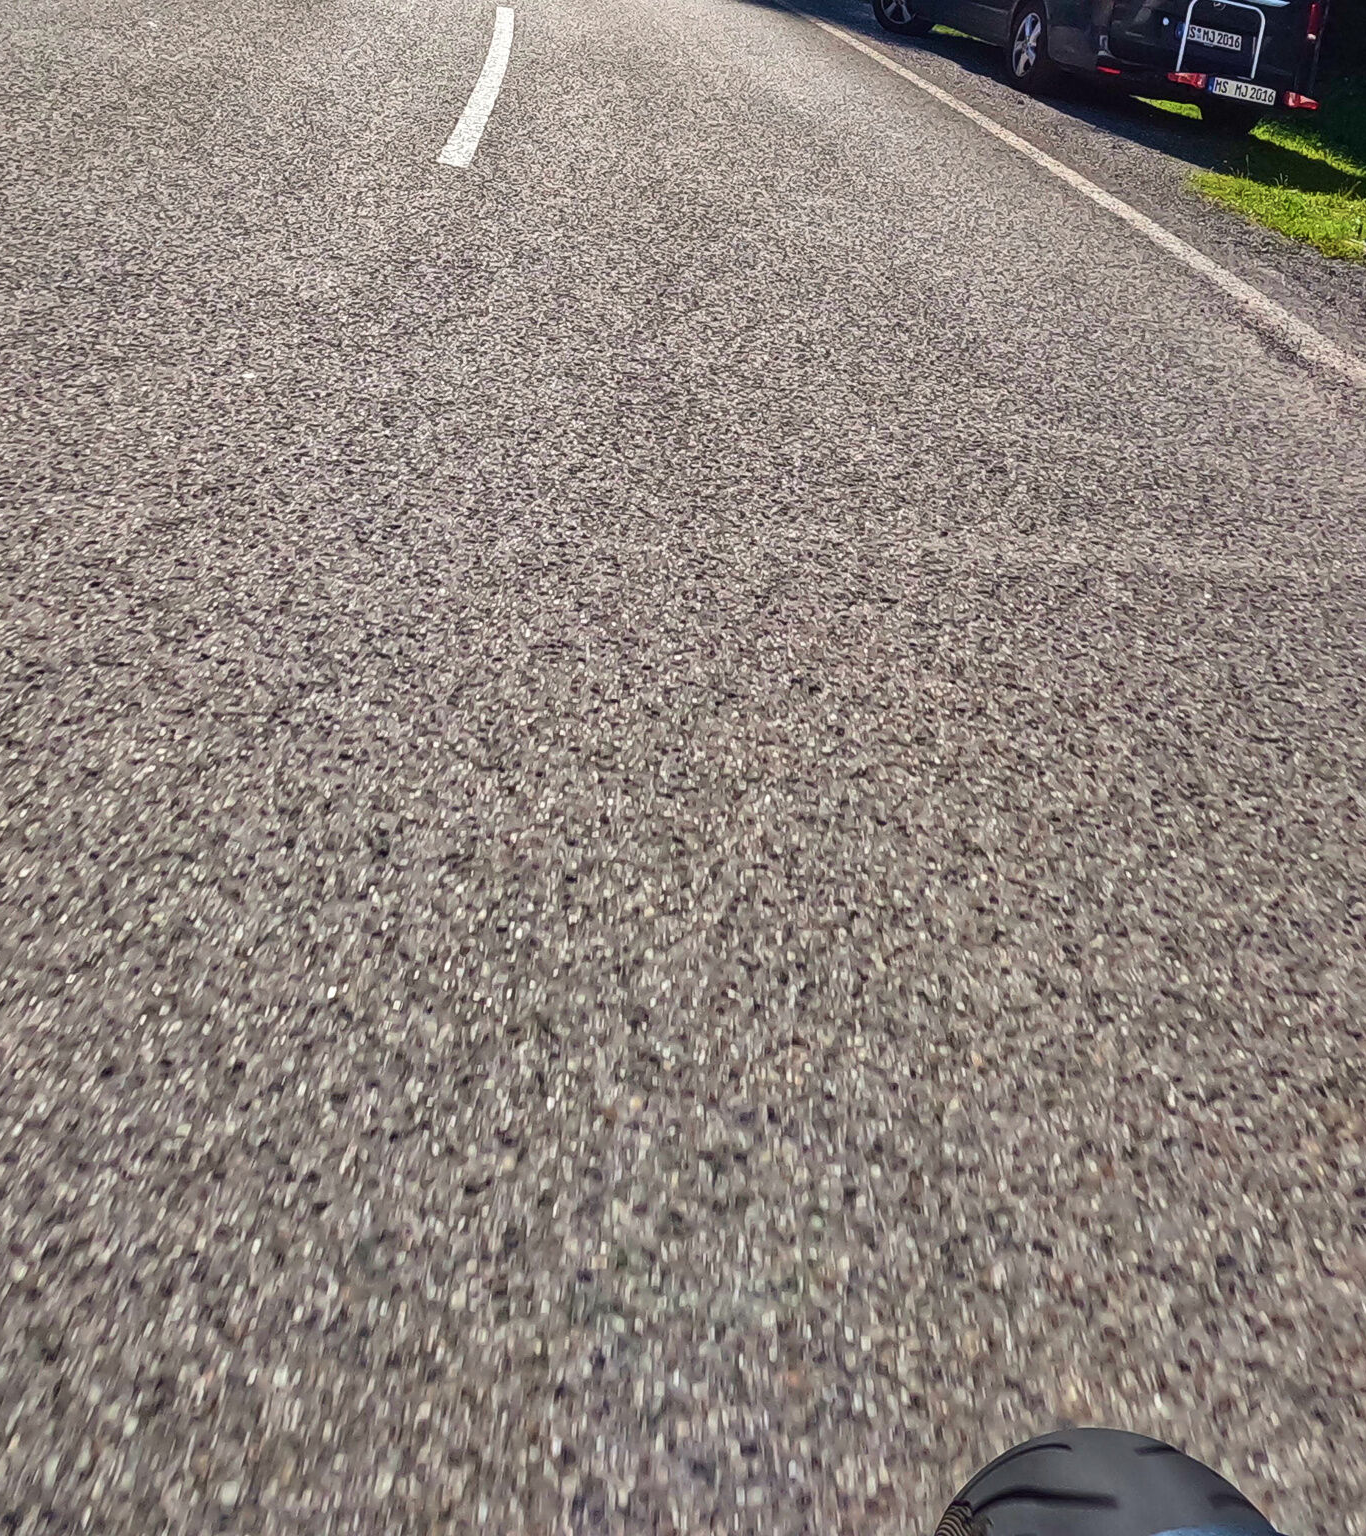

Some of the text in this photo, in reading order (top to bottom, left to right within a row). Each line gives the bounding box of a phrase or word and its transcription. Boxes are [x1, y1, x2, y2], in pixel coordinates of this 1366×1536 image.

[1217, 32, 1241, 49] 2016
[1214, 79, 1275, 104] MS MJ 2016
